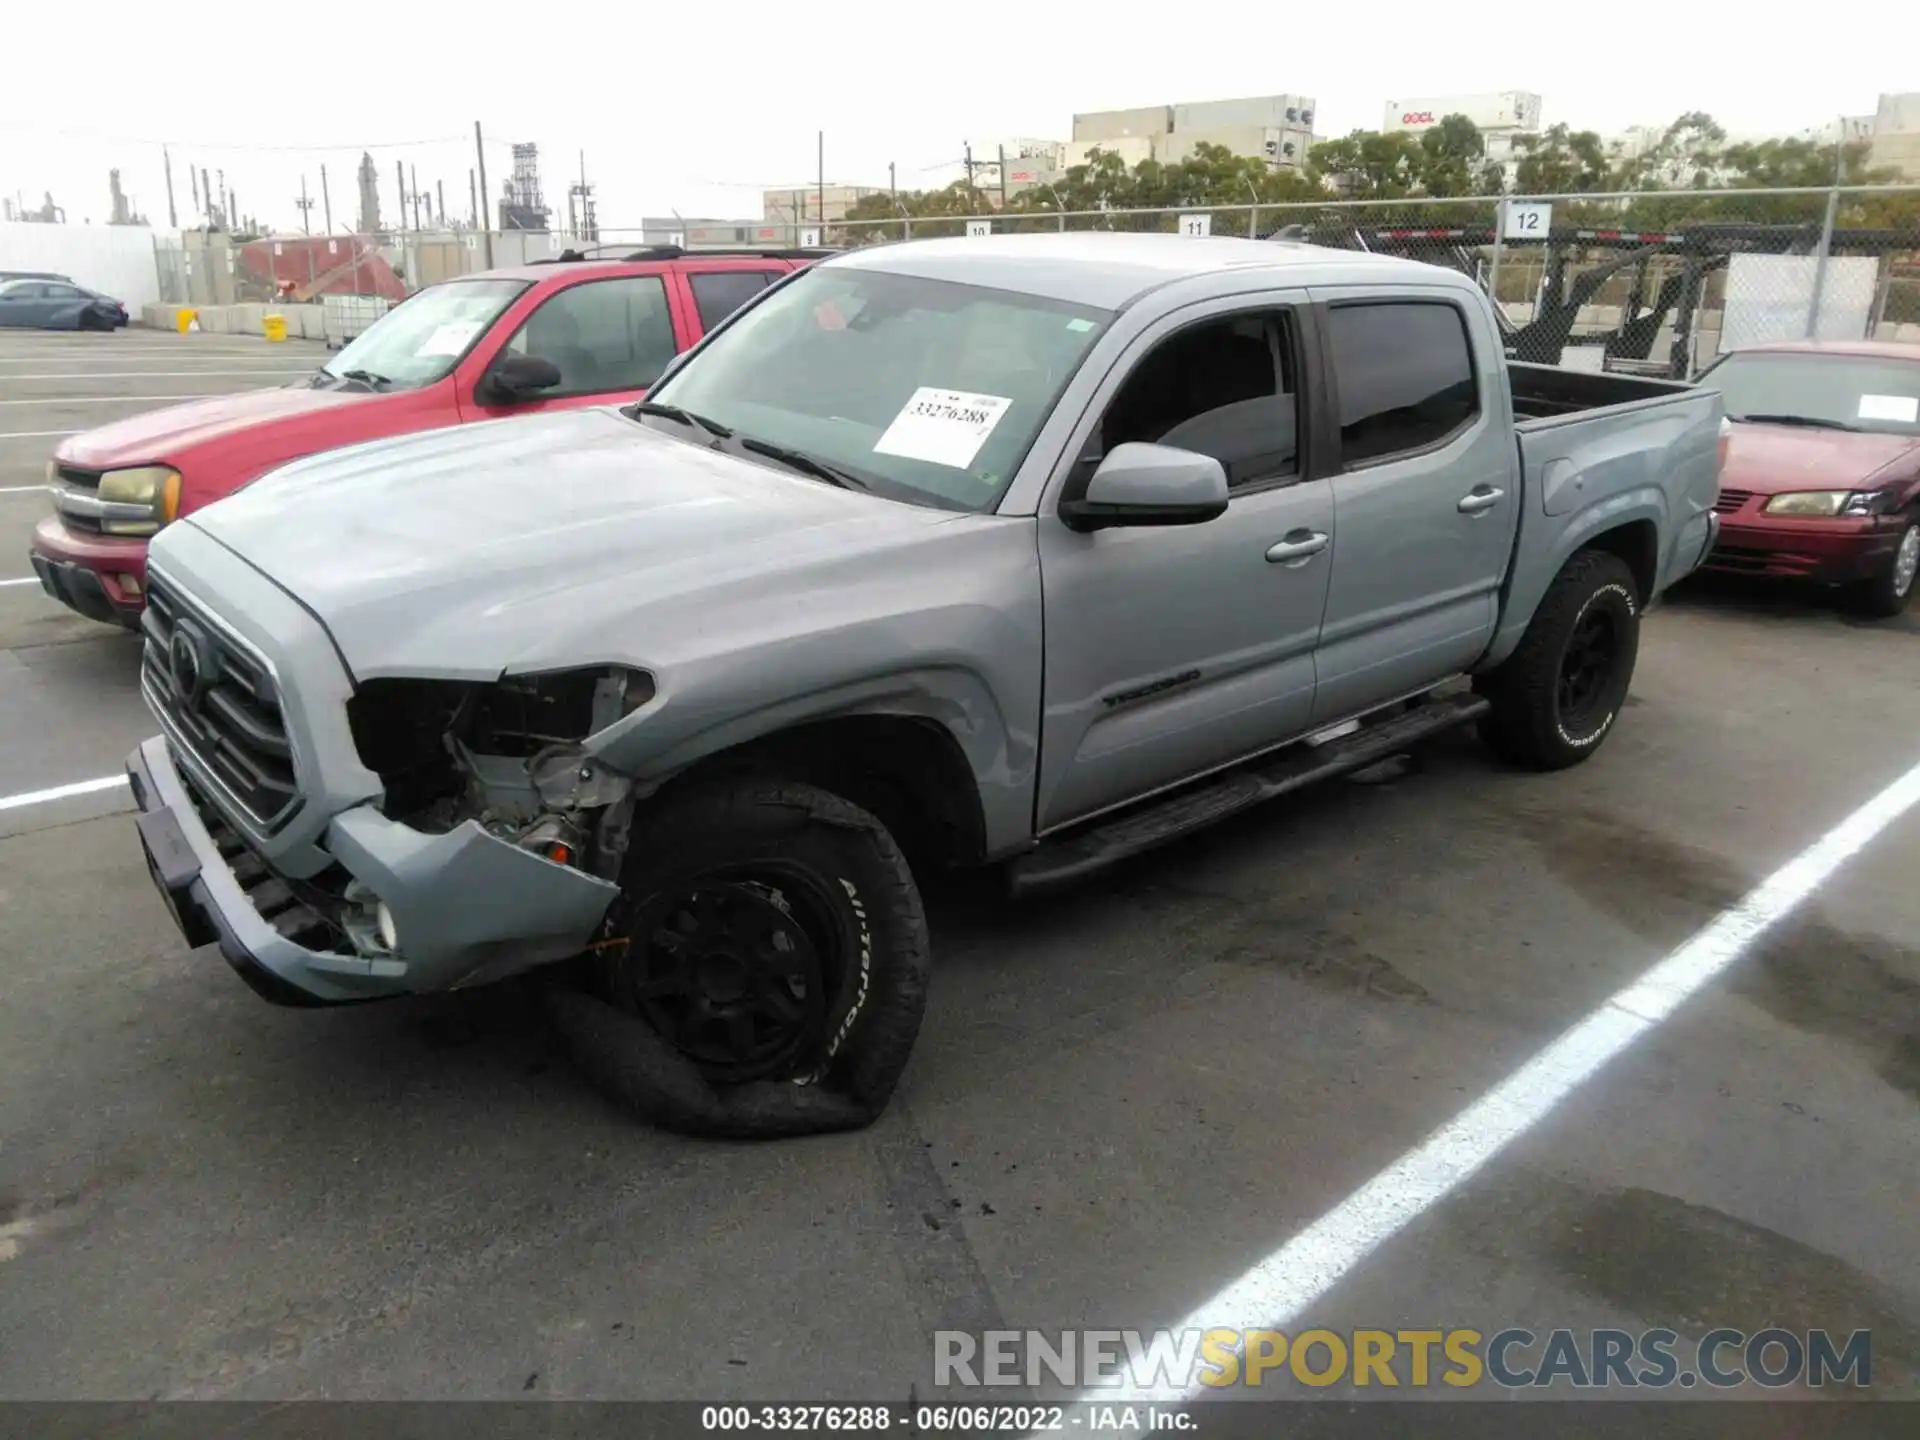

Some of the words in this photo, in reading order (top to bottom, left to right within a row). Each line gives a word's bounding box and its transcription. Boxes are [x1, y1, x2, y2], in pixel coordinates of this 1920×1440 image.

[1402, 111, 1435, 124] OOCL
[1189, 221, 1203, 236] 11
[1518, 212, 1540, 229] 12
[909, 401, 990, 425] 33276288
